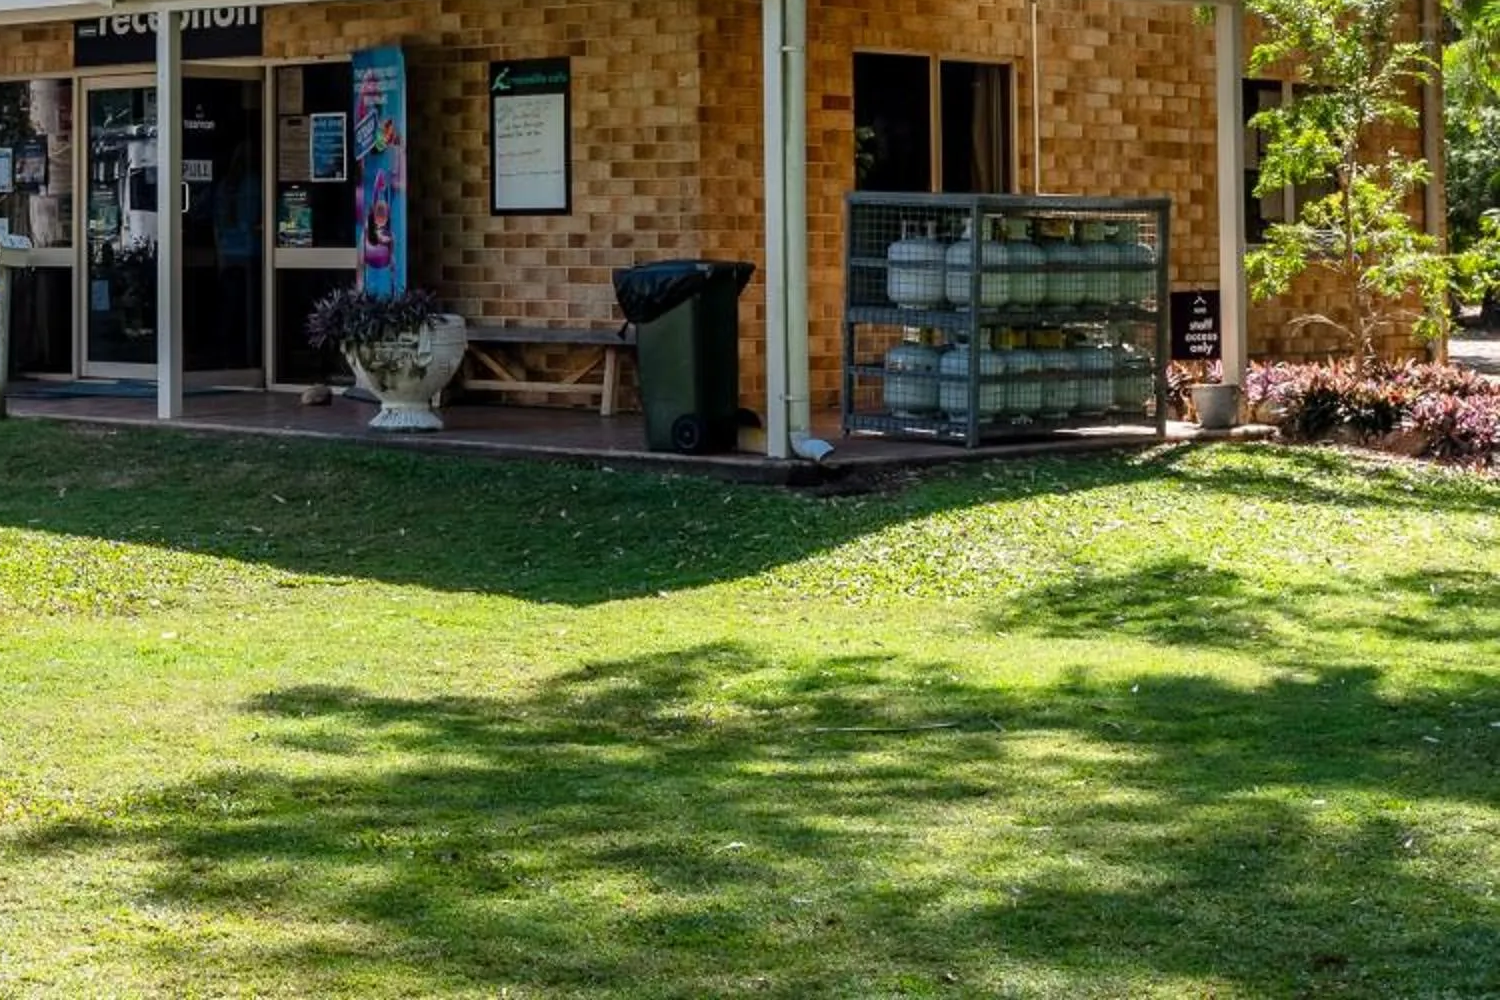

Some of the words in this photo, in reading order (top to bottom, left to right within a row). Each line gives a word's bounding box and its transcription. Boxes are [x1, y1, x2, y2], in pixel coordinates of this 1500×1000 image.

[1189, 318, 1213, 331] staff
[1185, 333, 1217, 342] access
[1189, 342, 1213, 355] only
